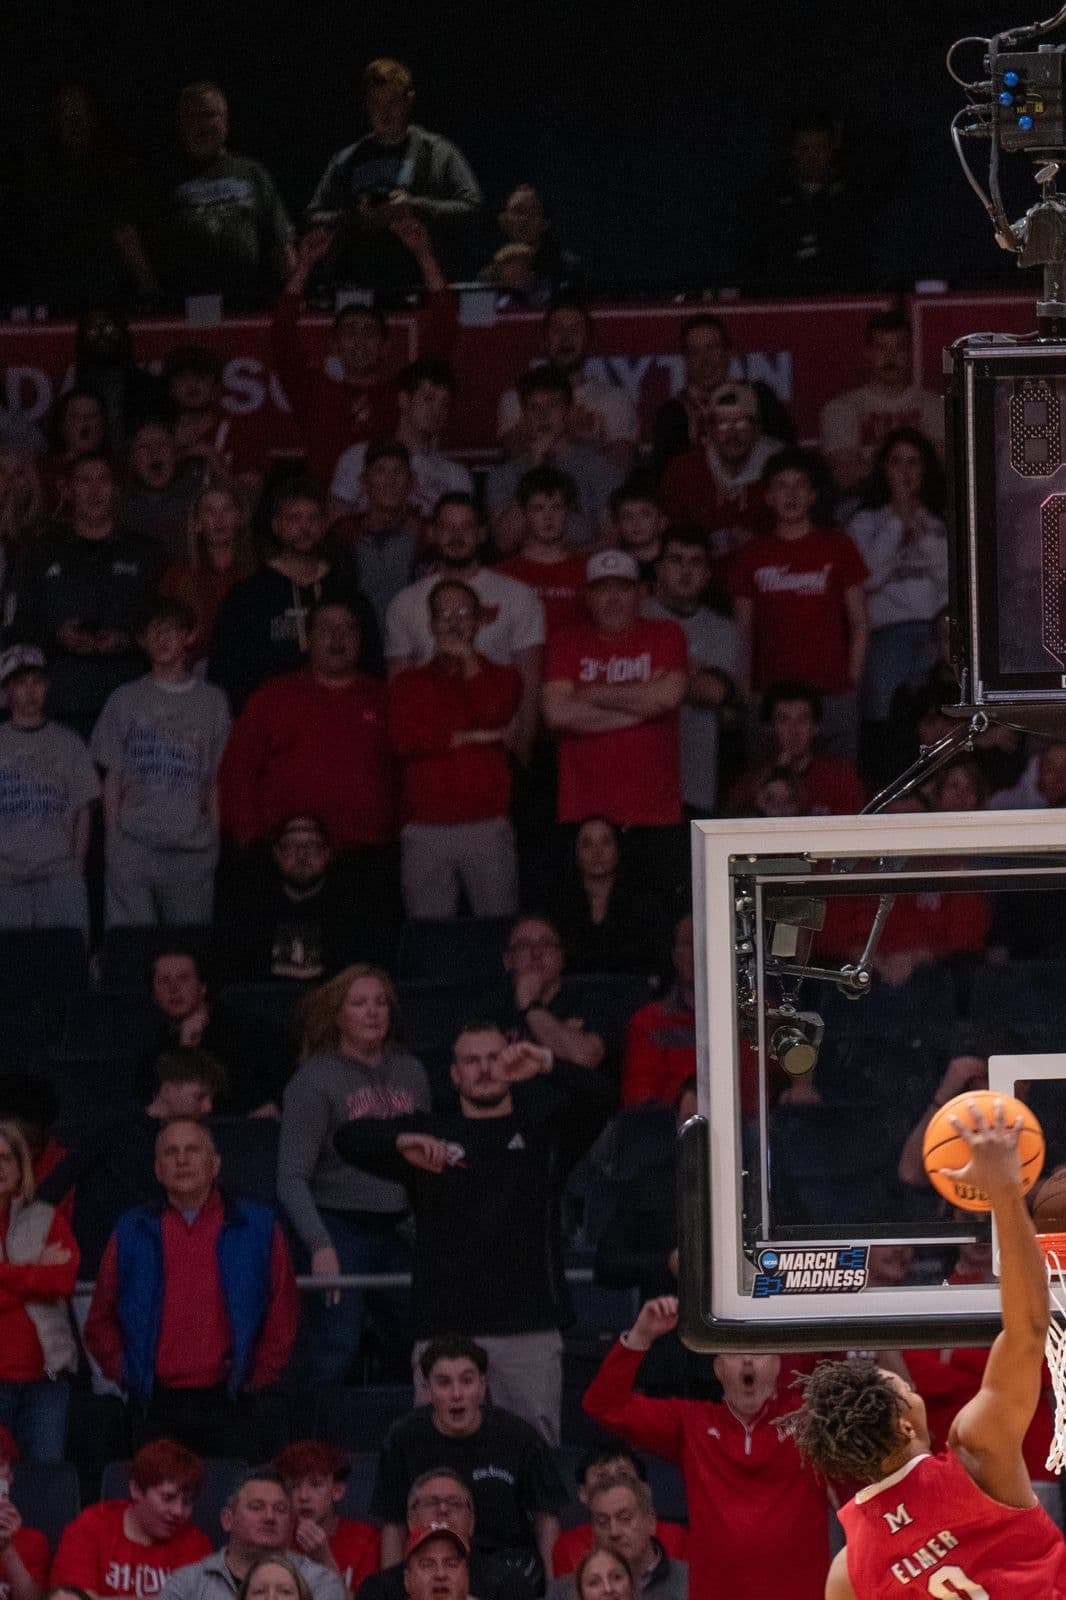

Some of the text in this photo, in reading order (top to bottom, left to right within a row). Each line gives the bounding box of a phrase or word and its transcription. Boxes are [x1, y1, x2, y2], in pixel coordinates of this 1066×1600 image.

[778, 1252, 838, 1271] MARCH
[785, 1269, 866, 1289] MADNESS
[882, 1503, 914, 1534] M
[890, 1530, 959, 1585] ELMER
